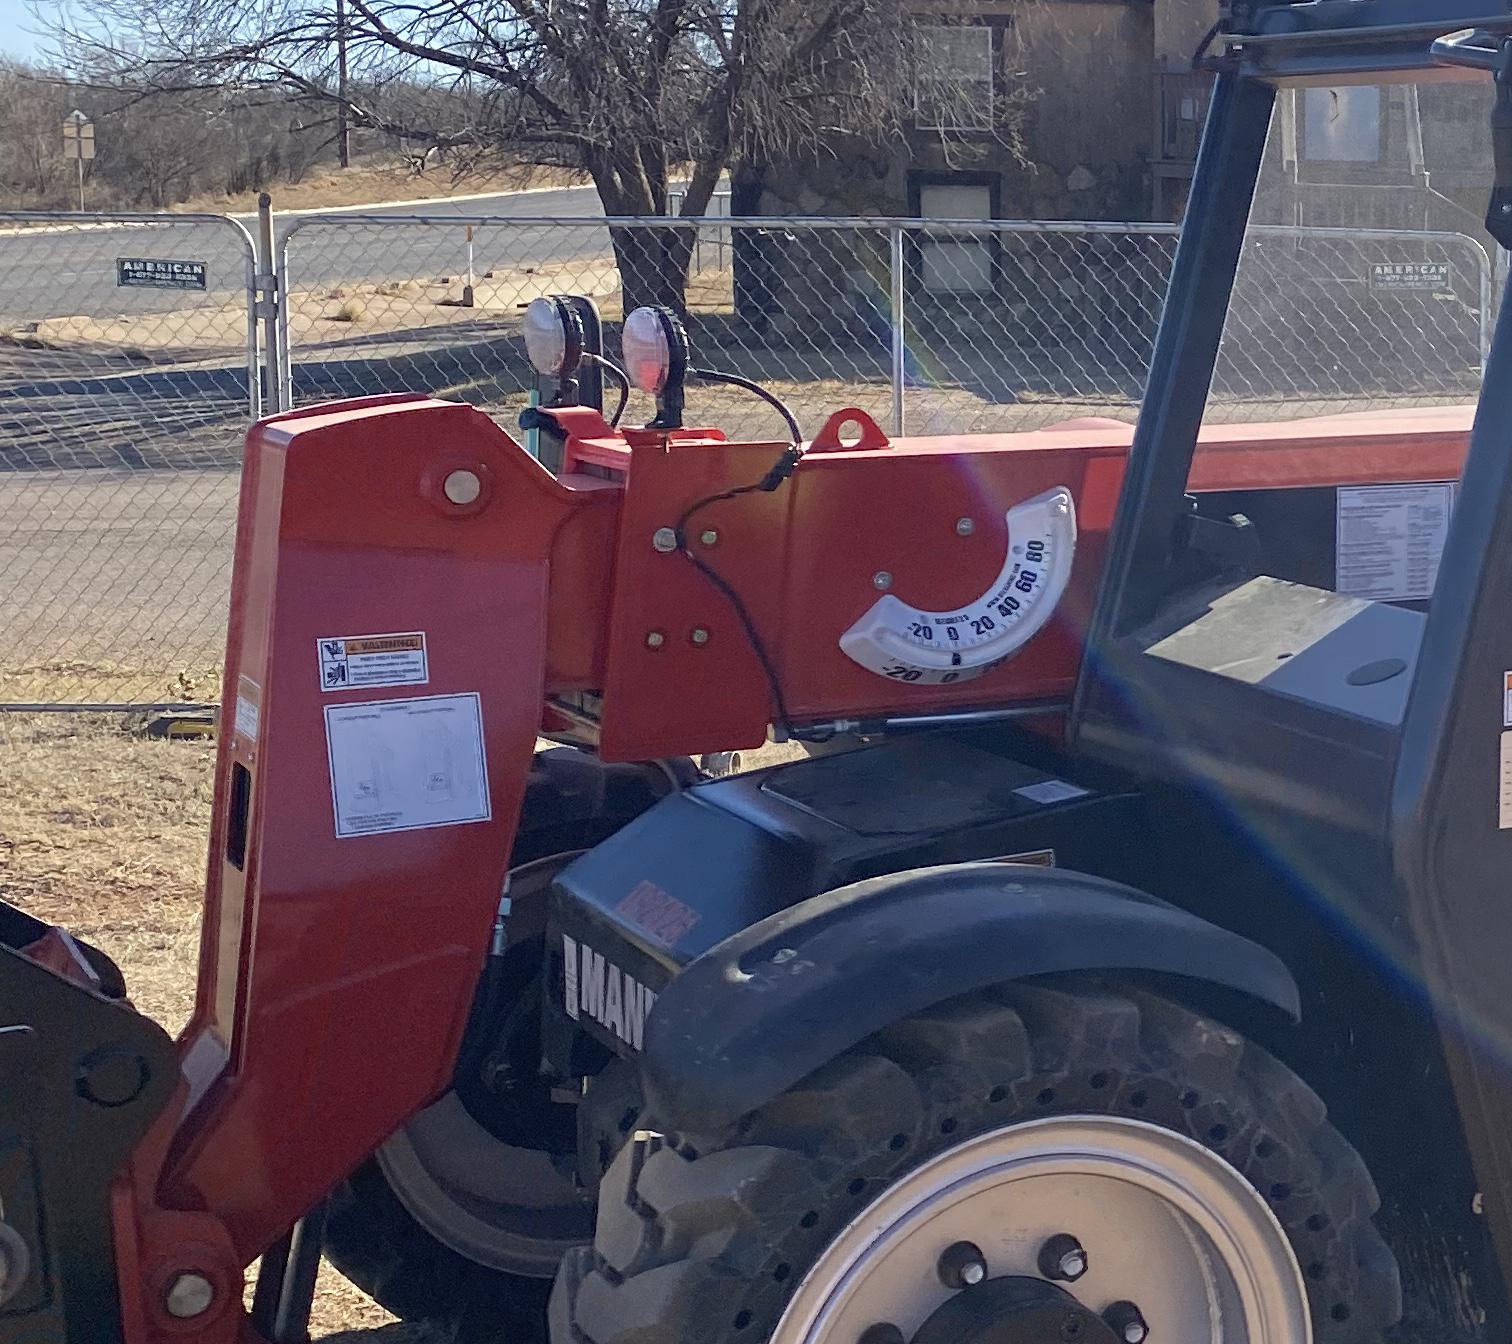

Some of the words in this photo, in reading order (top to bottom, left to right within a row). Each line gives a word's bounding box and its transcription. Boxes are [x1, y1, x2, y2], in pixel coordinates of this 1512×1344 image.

[123, 261, 202, 274] AMERICAN
[1375, 265, 1447, 274] AMERICAN
[1026, 540, 1045, 563] 80
[1015, 570, 1038, 593] 60
[998, 595, 1020, 617] 40
[908, 622, 933, 640] -20
[946, 627, 960, 641] 0
[970, 615, 995, 636] 20
